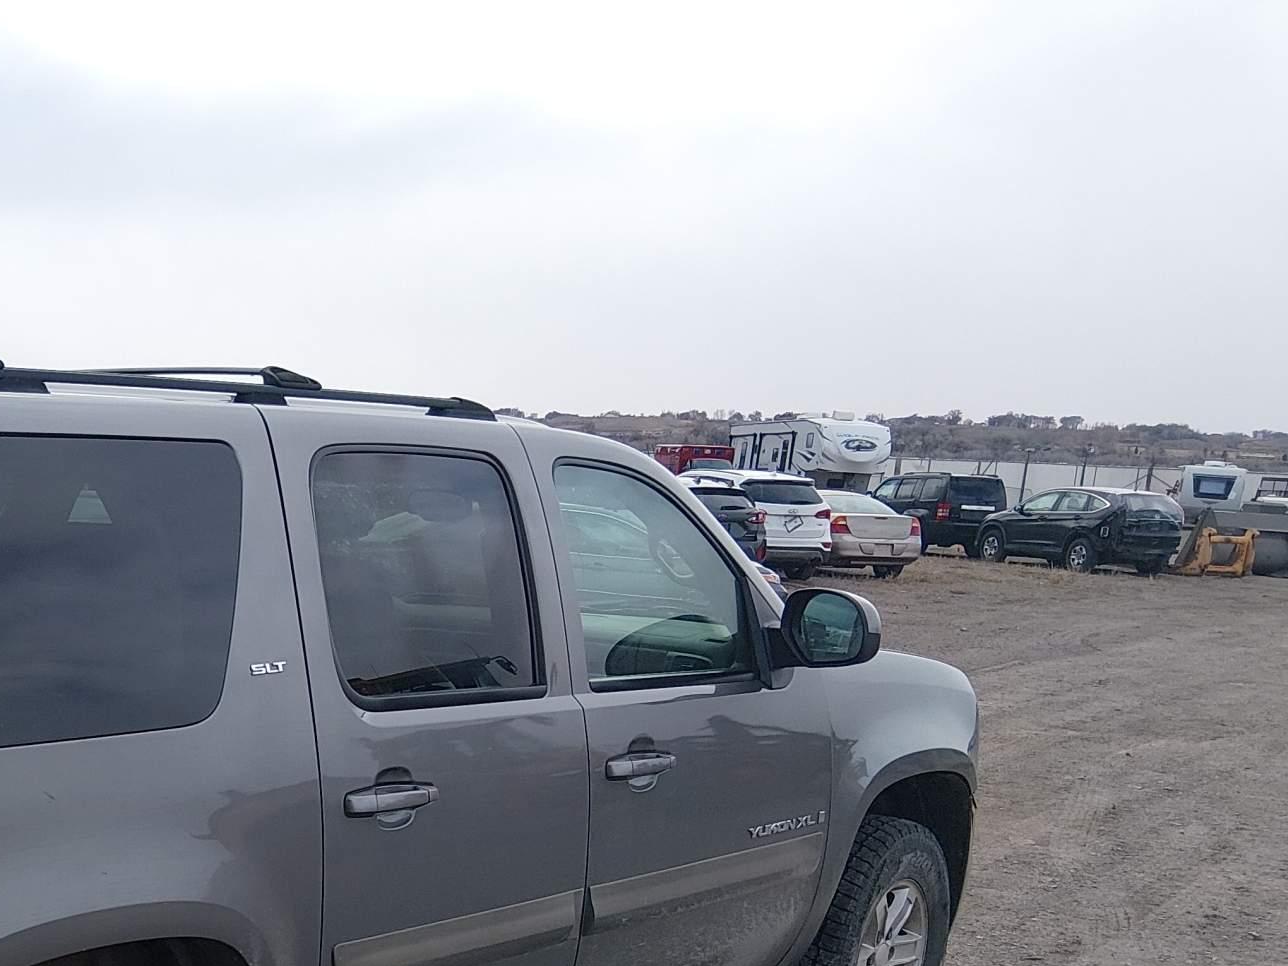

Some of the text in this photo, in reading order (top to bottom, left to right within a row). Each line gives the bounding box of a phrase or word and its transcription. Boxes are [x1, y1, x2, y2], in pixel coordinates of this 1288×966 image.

[250, 661, 287, 675] SLT
[749, 814, 816, 838] YUKON XL
